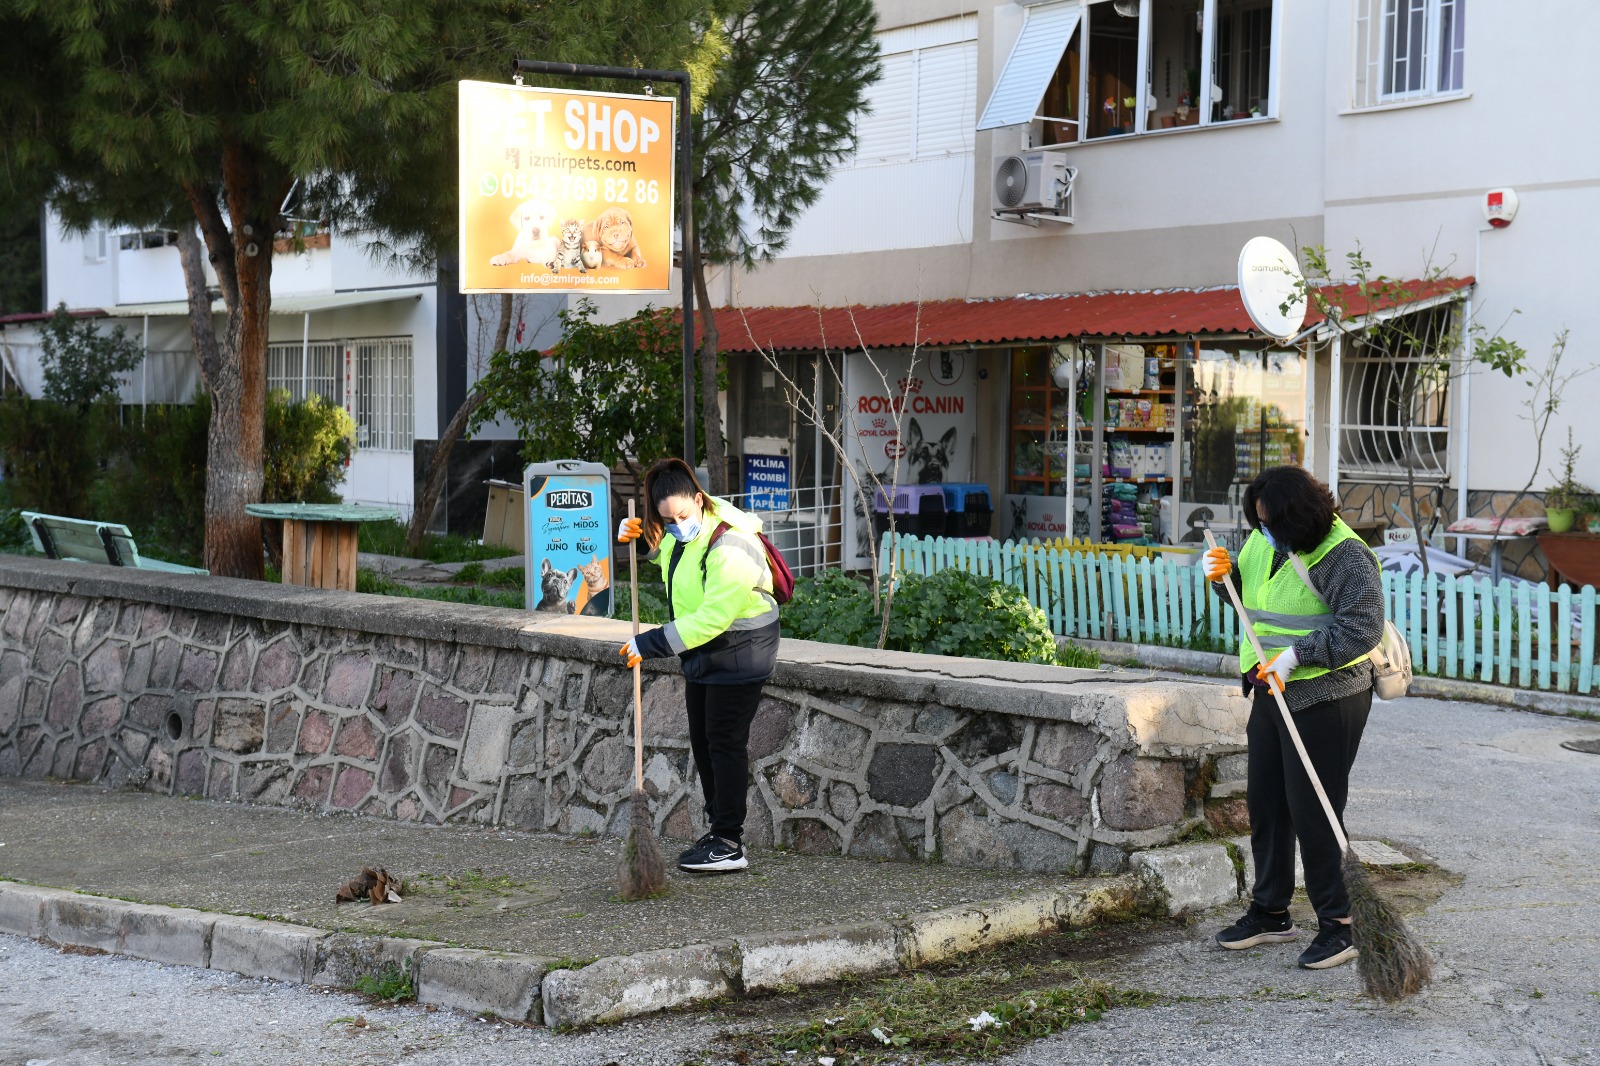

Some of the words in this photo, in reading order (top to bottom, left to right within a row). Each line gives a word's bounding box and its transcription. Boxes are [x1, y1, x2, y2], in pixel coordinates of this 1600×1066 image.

[480, 97, 552, 148] PET
[564, 99, 660, 154] SHOP
[529, 150, 637, 174] izmirpets.com
[501, 172, 554, 200] 0542
[561, 175, 598, 202] 769
[604, 177, 629, 203] 82
[635, 179, 659, 204] 86
[520, 273, 619, 286] info@izmirpets.com
[858, 396, 908, 414] ROYAL
[912, 396, 964, 414] CANIN
[550, 491, 588, 507] PERITAS
[1027, 522, 1047, 531] ROYAL
[1388, 531, 1411, 542] Rico
[546, 543, 569, 551] JUNO
[576, 542, 598, 554] Rico
